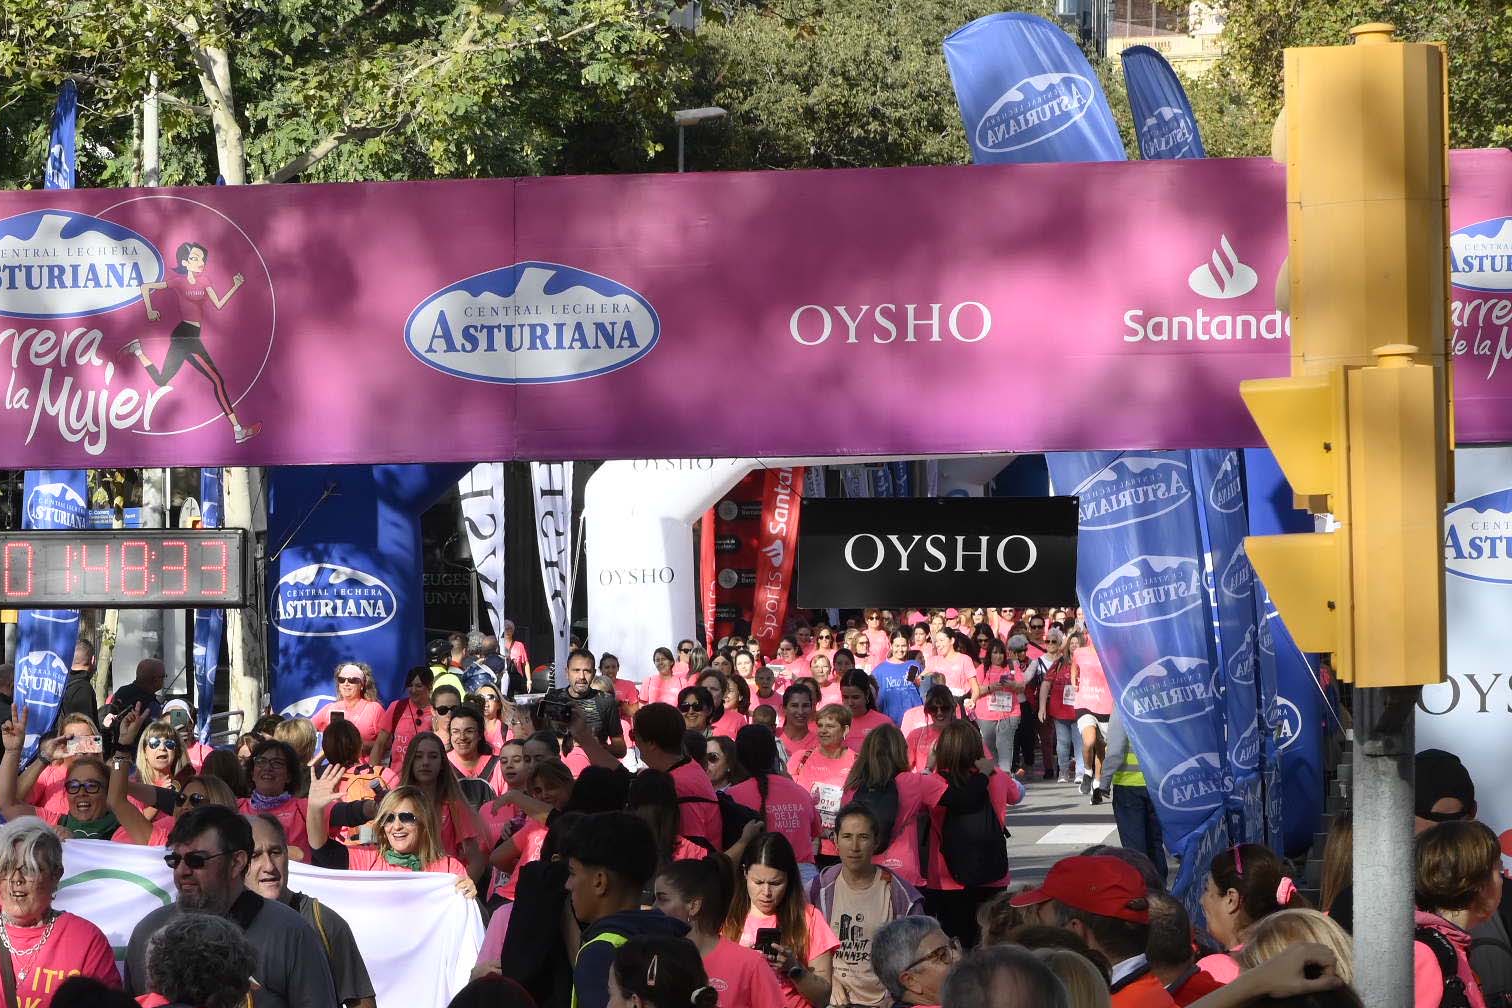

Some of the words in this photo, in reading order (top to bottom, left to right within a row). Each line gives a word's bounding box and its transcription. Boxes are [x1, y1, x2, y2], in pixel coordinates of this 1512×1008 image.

[66, 245, 140, 258] LECHERA
[464, 303, 543, 317] CENTRAL
[551, 302, 633, 316] LECHERA
[789, 301, 993, 347] OYSHO
[424, 308, 641, 355] ASTURIANA
[5, 370, 31, 411] la
[25, 362, 174, 456] Mujer
[4, 540, 228, 597] 01:48:33
[844, 533, 1038, 574] OYSHO
[287, 588, 329, 598] CENTRAL
[334, 588, 383, 597] LECHERA
[599, 565, 676, 586] OYSHO
[274, 593, 387, 620] ASTURIANA
[756, 571, 783, 640] Sports
